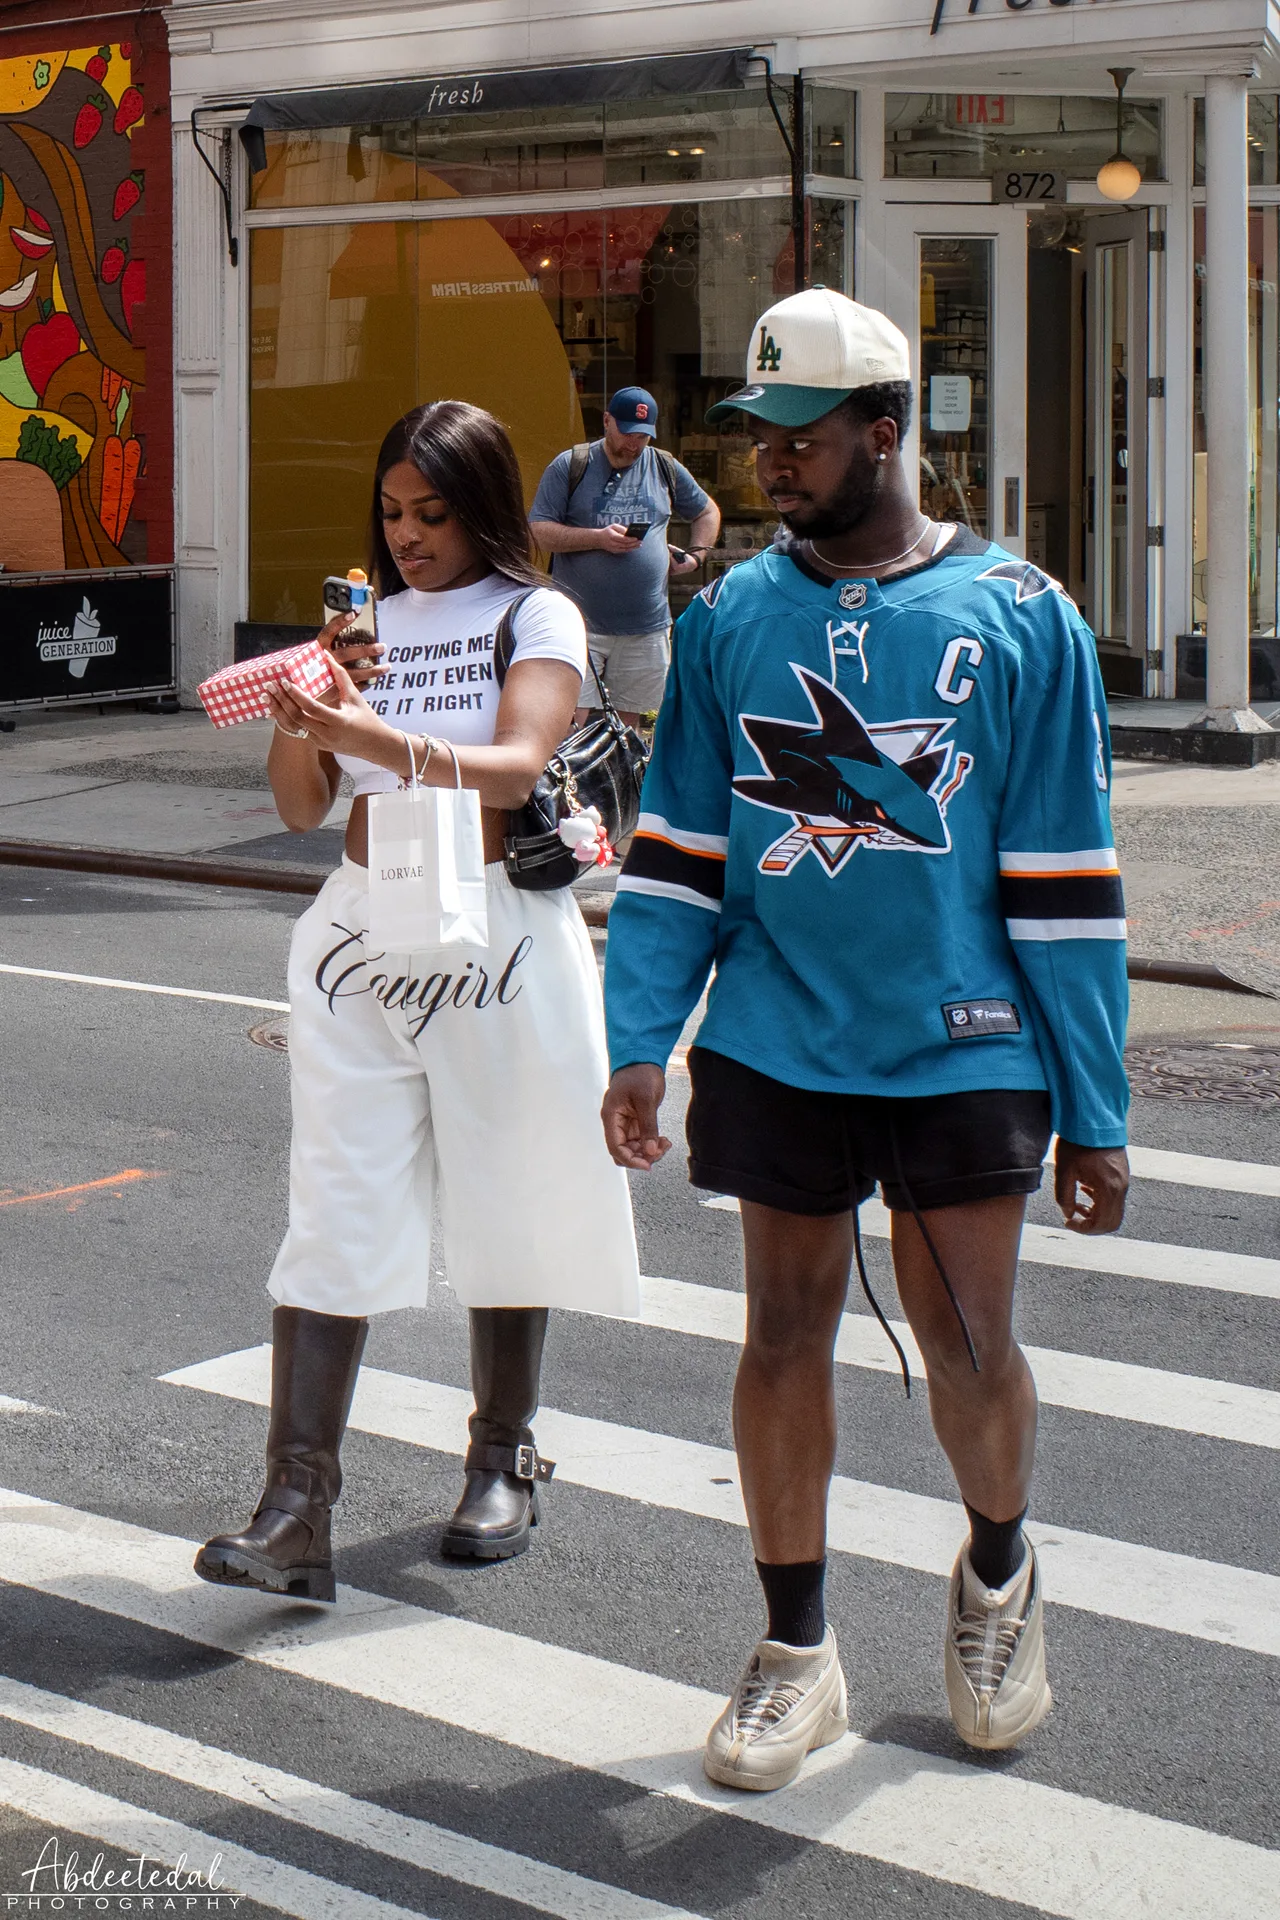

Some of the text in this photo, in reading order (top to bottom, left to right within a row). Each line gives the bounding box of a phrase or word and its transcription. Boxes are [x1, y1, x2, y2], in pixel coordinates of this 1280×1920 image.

[427, 81, 484, 113] fresh
[1005, 173, 1056, 199] 872
[757, 325, 782, 371] LA
[635, 403, 649, 420] S
[596, 513, 652, 526] MOTEL
[36, 620, 72, 648] juice
[42, 640, 114, 658] GENERATION
[387, 633, 494, 663] COPYING ME
[401, 670, 438, 689] NOT
[444, 662, 493, 685] EVEN
[933, 635, 984, 707] C
[396, 698, 414, 715] IT
[423, 692, 483, 713] RIGHT
[380, 865, 424, 881] LORVAE
[315, 922, 534, 1040] Cowgirl
